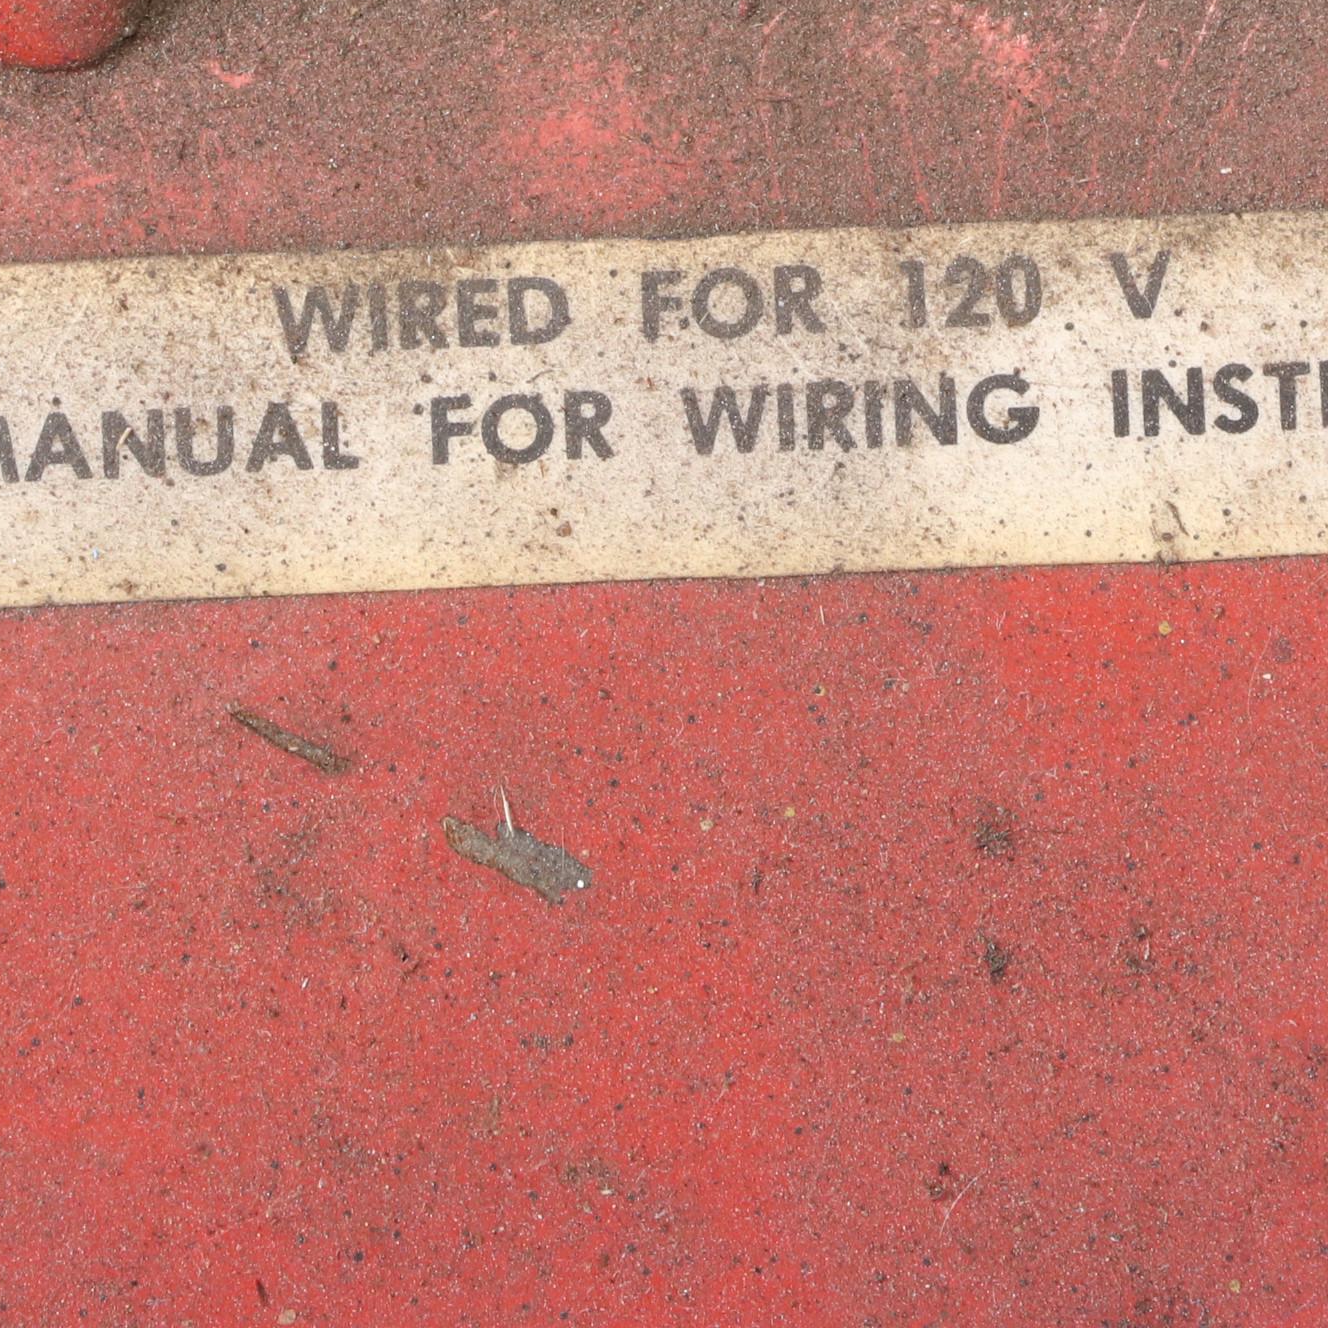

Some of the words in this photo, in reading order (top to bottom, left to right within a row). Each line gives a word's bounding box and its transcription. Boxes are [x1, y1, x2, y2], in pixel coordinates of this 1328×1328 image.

[276, 274, 569, 356] WIRED
[641, 265, 826, 341] FOR
[899, 255, 1043, 329] 120
[1109, 250, 1175, 320] V
[430, 390, 613, 465] FOR
[681, 372, 1040, 456] WIRING
